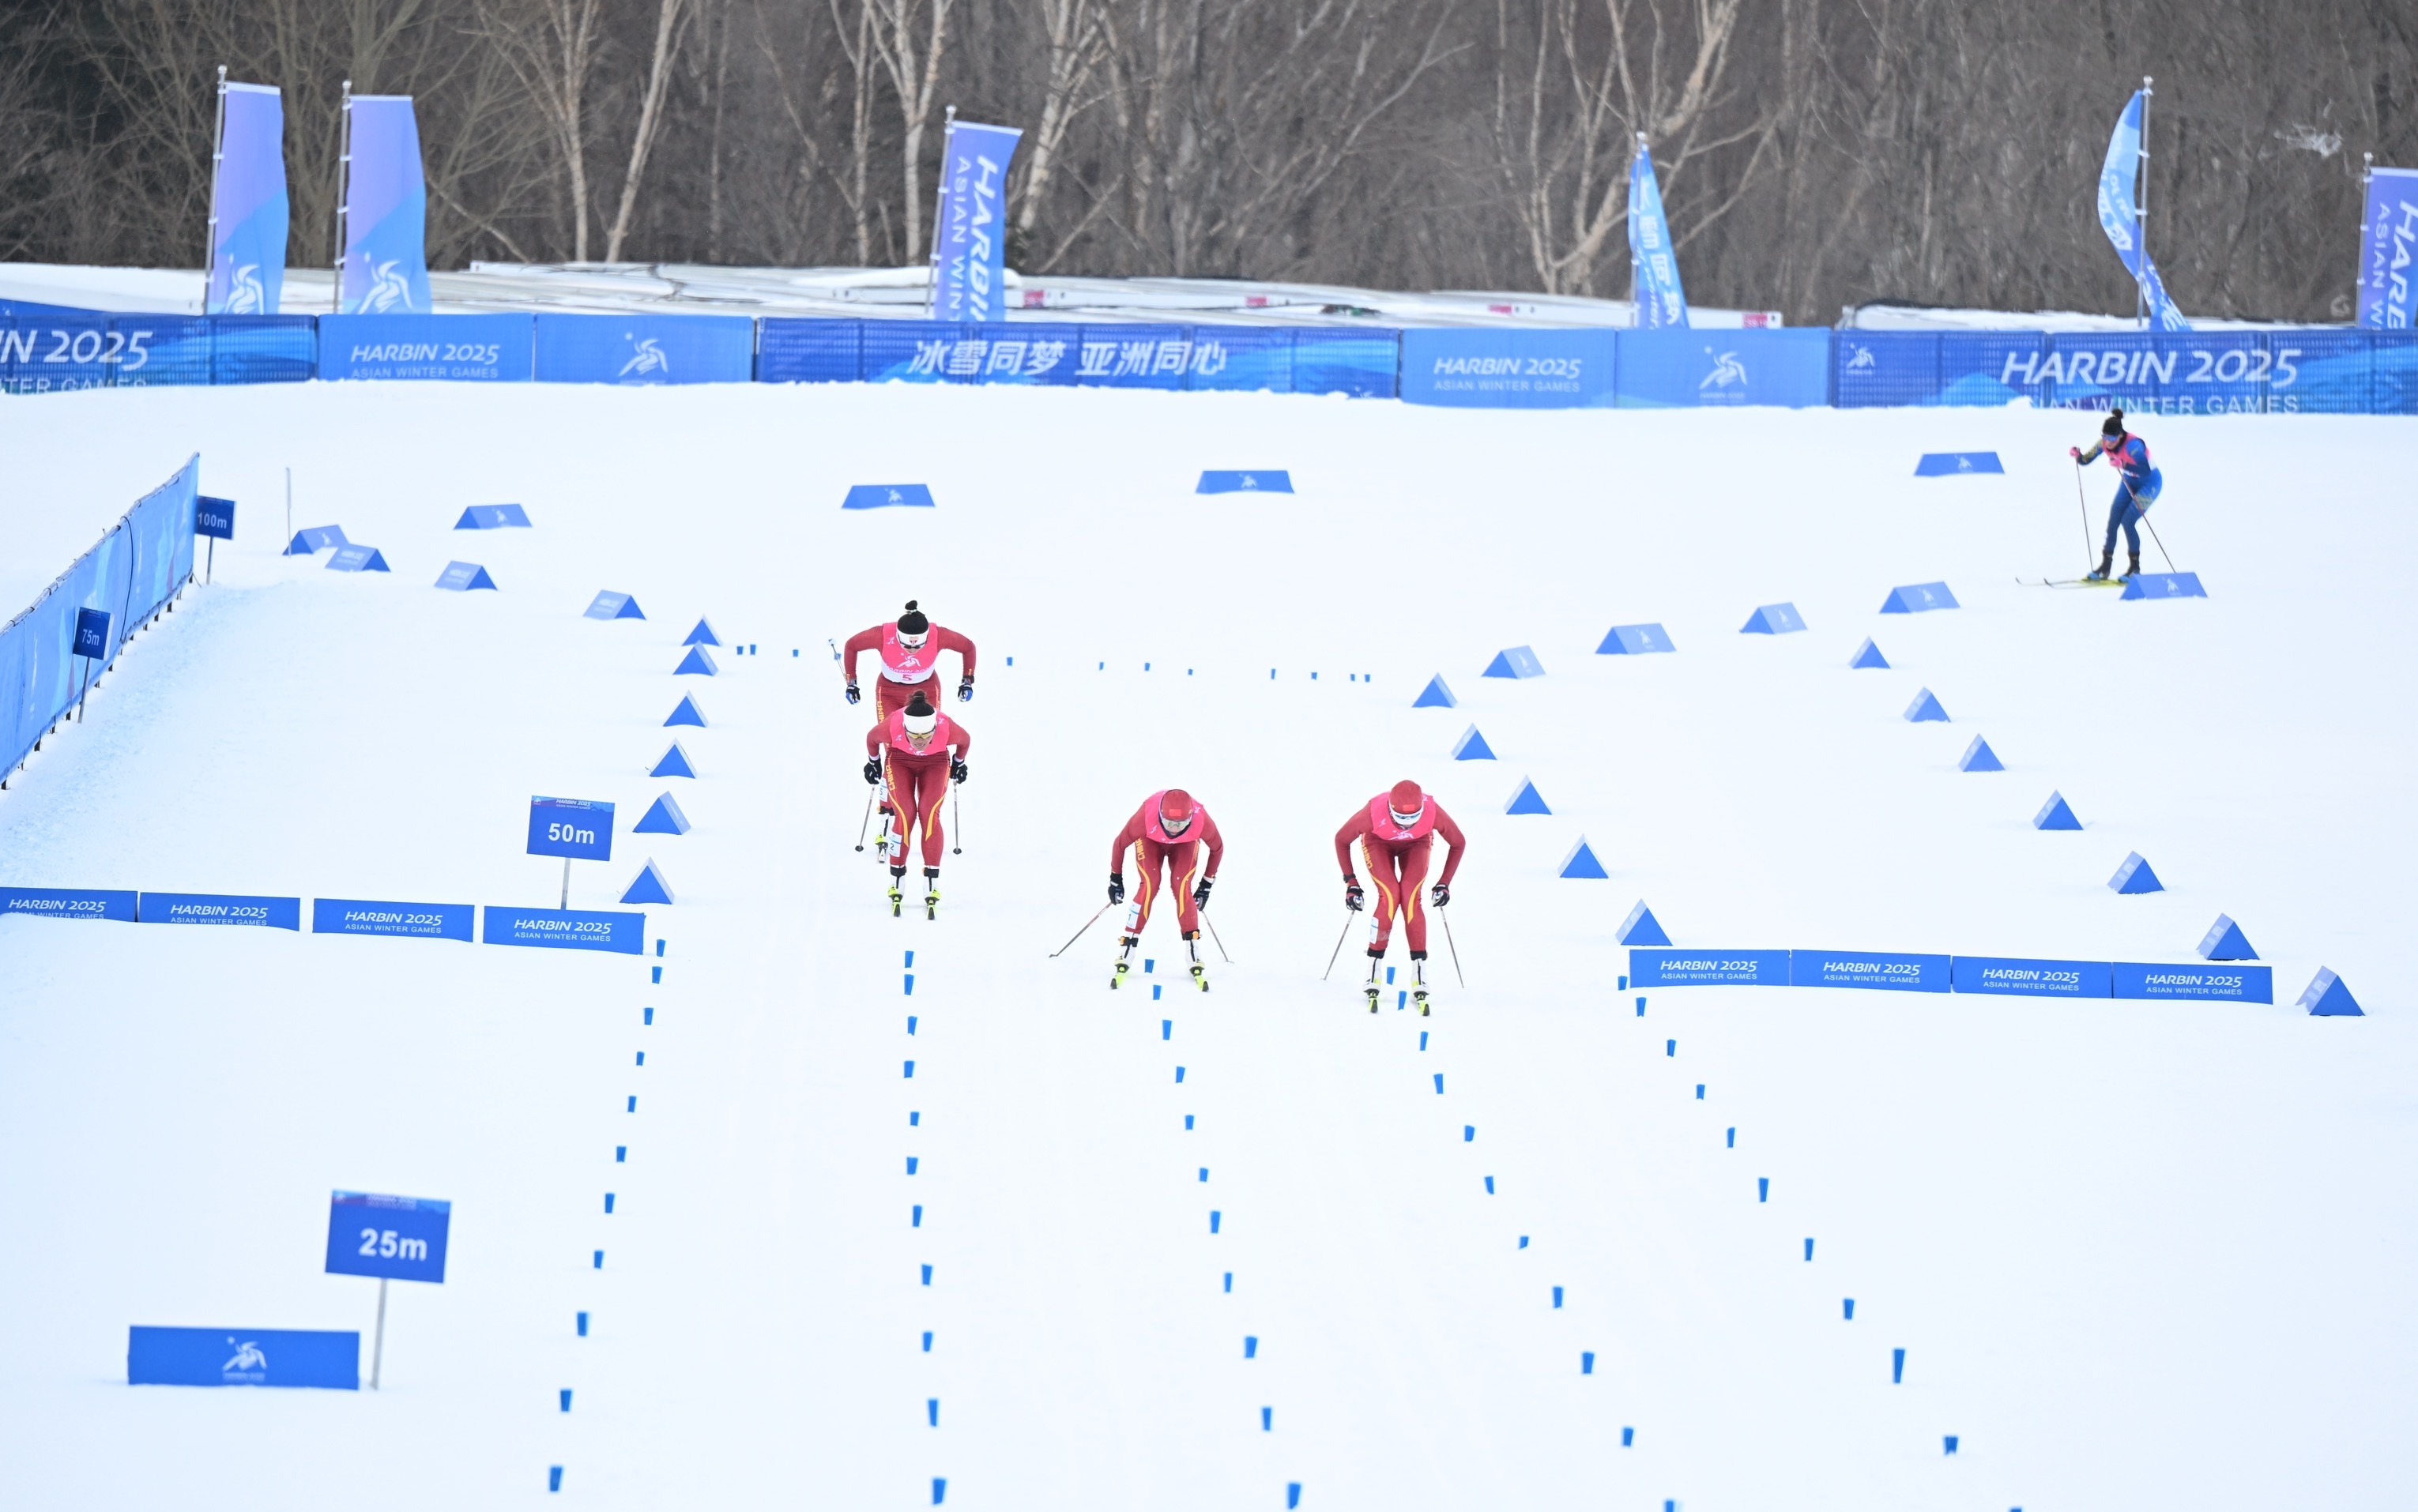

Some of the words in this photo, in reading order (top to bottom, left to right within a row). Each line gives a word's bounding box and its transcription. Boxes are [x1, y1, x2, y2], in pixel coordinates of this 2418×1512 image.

[951, 156, 972, 243] ASIAN
[2371, 201, 2392, 288] ASIAN
[43, 329, 153, 371] 2025
[351, 344, 439, 363] HARBIN
[442, 343, 500, 365] 2025
[906, 340, 1066, 376] 冰雪同梦
[1074, 340, 1226, 376] 亚洲同心
[351, 367, 392, 378] ASIAN
[397, 367, 447, 378] WINTER
[451, 368, 499, 378] GAMES
[1433, 358, 1522, 375] HARBIN
[1525, 358, 1582, 379] 2025
[2000, 351, 2178, 385] HARBIN
[2186, 349, 2302, 389] 2025
[0, 378, 51, 393] TER
[1434, 380, 1474, 391] ASIAN
[1478, 381, 1530, 392] WINTER
[1534, 382, 1580, 393] GAMES
[2092, 397, 2194, 416] WINTER
[2205, 395, 2299, 416] GAMES
[198, 512, 228, 529] 100m
[82, 628, 100, 646] 75m
[885, 764, 896, 791] CHINA
[548, 822, 596, 844] 50m
[9, 899, 66, 910] HARBIN
[68, 901, 106, 912] 2025
[170, 905, 228, 916] HARBIN
[230, 906, 269, 919] 2025
[345, 911, 403, 923] HARBIN
[405, 913, 443, 927] 2025
[514, 919, 572, 931] HARBIN
[574, 922, 612, 935] 2025
[1660, 961, 1718, 971] HARBIN
[1719, 961, 1757, 972] 2025
[1823, 961, 1881, 973] HARBIN
[1883, 964, 1921, 976] 2025
[1982, 969, 2040, 980] HARBIN
[2042, 971, 2080, 984] 2025
[2145, 974, 2202, 985] HARBIN
[2205, 976, 2243, 987] 2025
[358, 1227, 428, 1262] 25m
